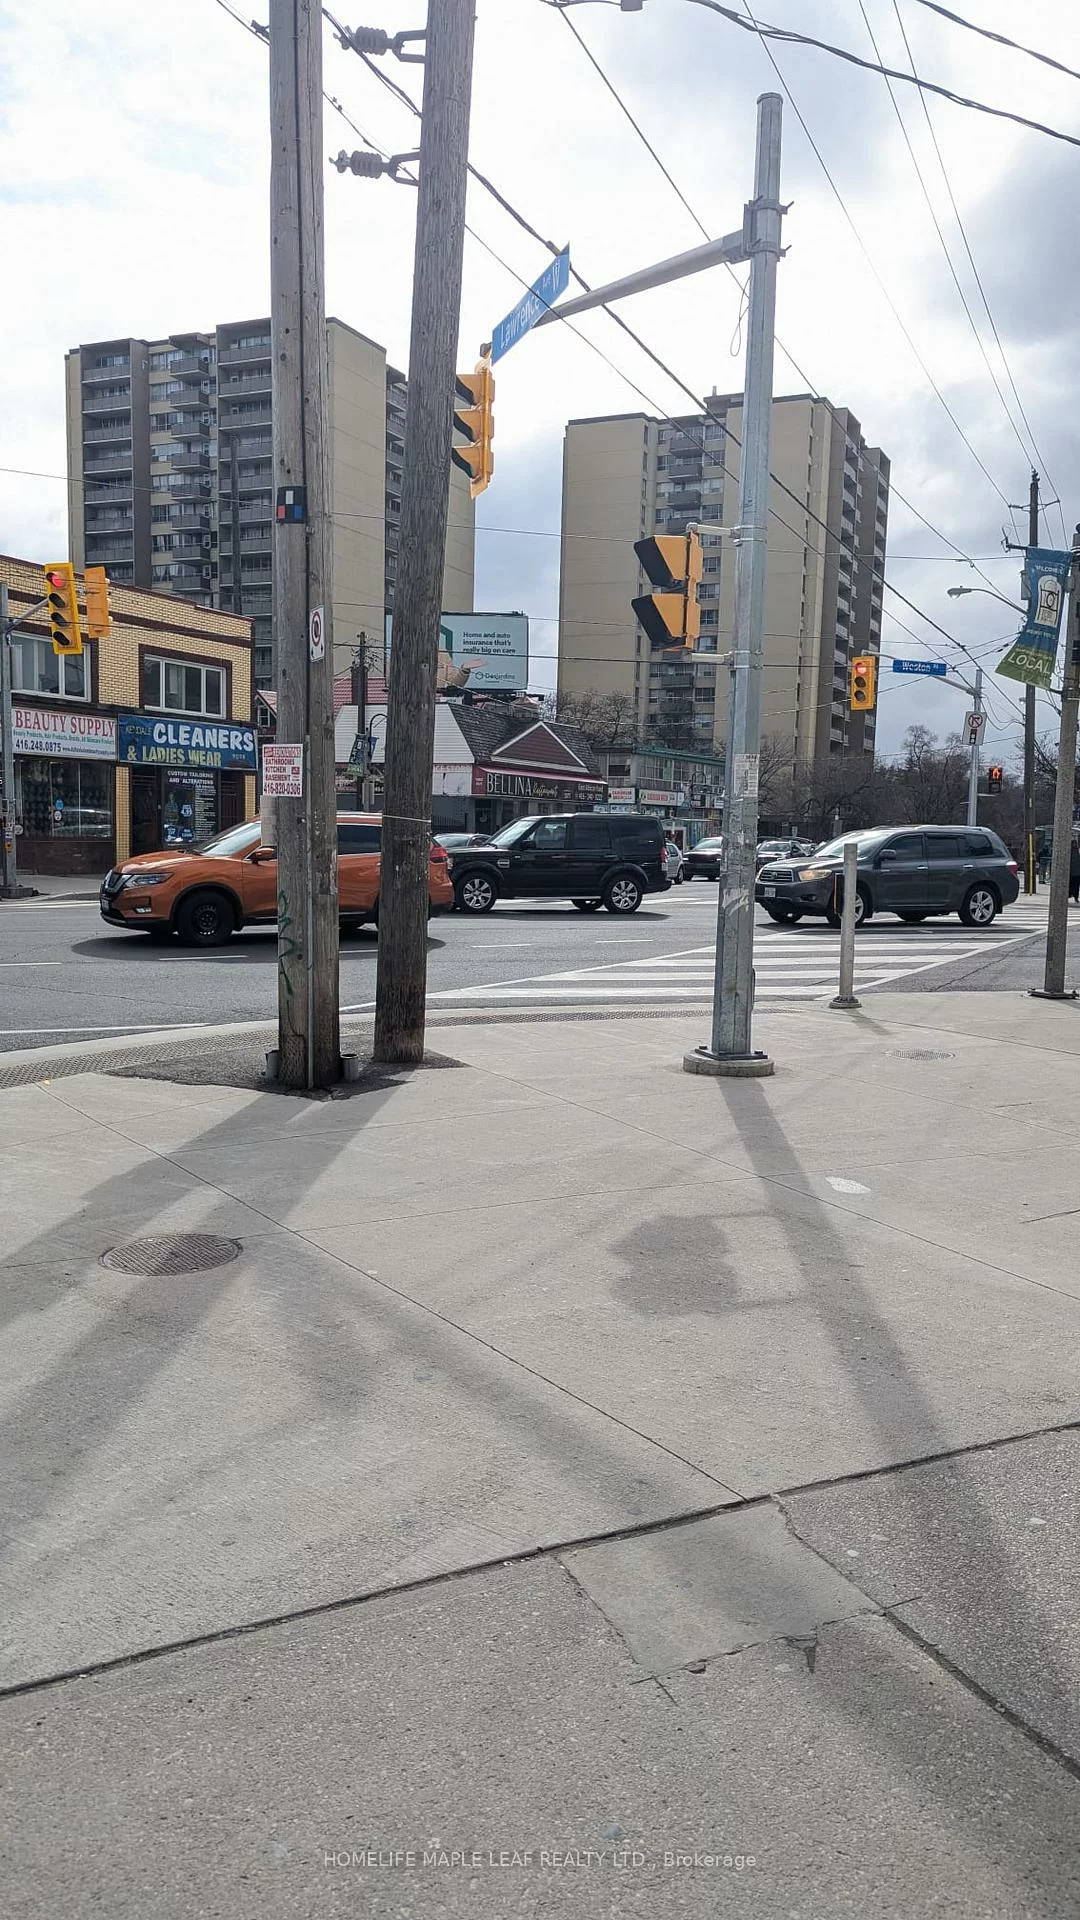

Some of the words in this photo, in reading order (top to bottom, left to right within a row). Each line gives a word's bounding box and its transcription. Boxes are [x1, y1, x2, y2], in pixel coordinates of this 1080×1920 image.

[500, 289, 540, 350] Lawrence
[552, 262, 560, 293] W
[481, 646, 492, 654] big
[902, 661, 931, 672] Weston
[1007, 651, 1050, 675] LOCAL
[15, 710, 67, 733] BEAUTY
[70, 716, 115, 737] SUPPLY
[153, 723, 254, 752] CLEANERS
[127, 745, 137, 761] &
[142, 745, 185, 764] LADIES
[188, 749, 222, 767] WEAR
[487, 773, 532, 796] BELLINA
